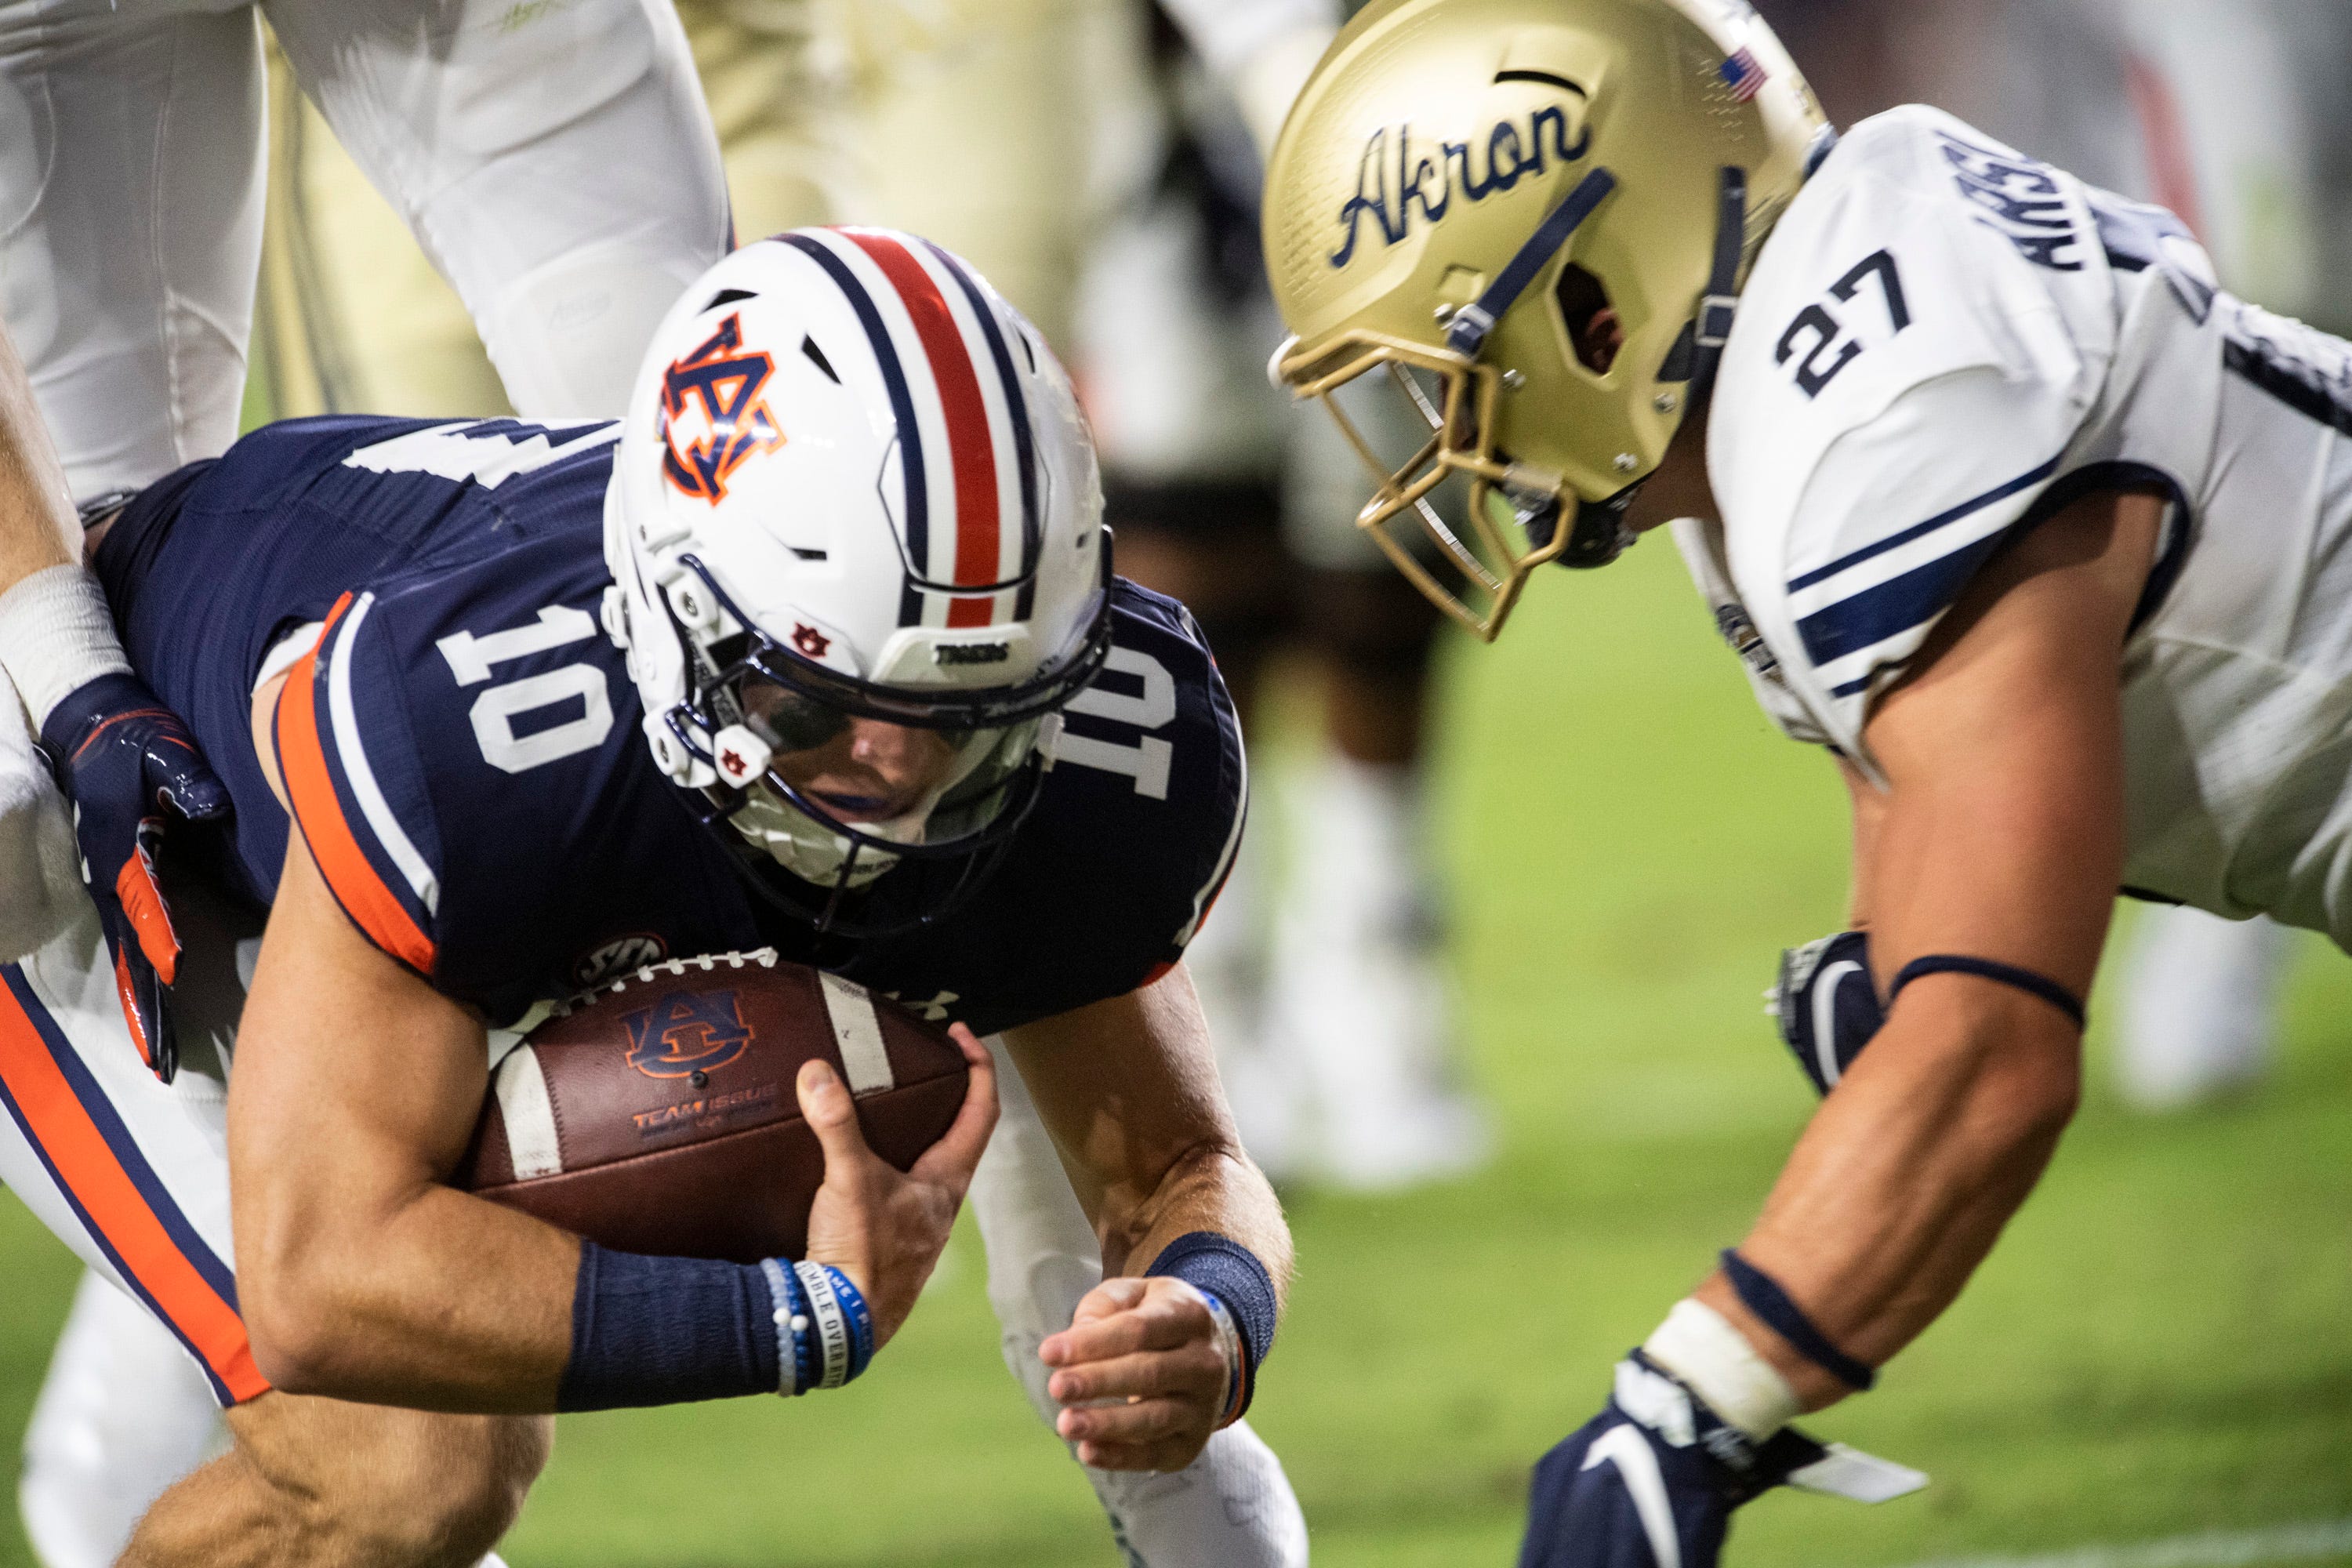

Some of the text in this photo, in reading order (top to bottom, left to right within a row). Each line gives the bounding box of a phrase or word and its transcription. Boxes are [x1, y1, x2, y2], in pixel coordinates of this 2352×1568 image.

[1330, 106, 1592, 268] Akron
[1775, 249, 1911, 399] 27
[435, 604, 615, 775] 10
[935, 641, 1008, 665] TIGERS
[825, 1319, 844, 1363] OVER
